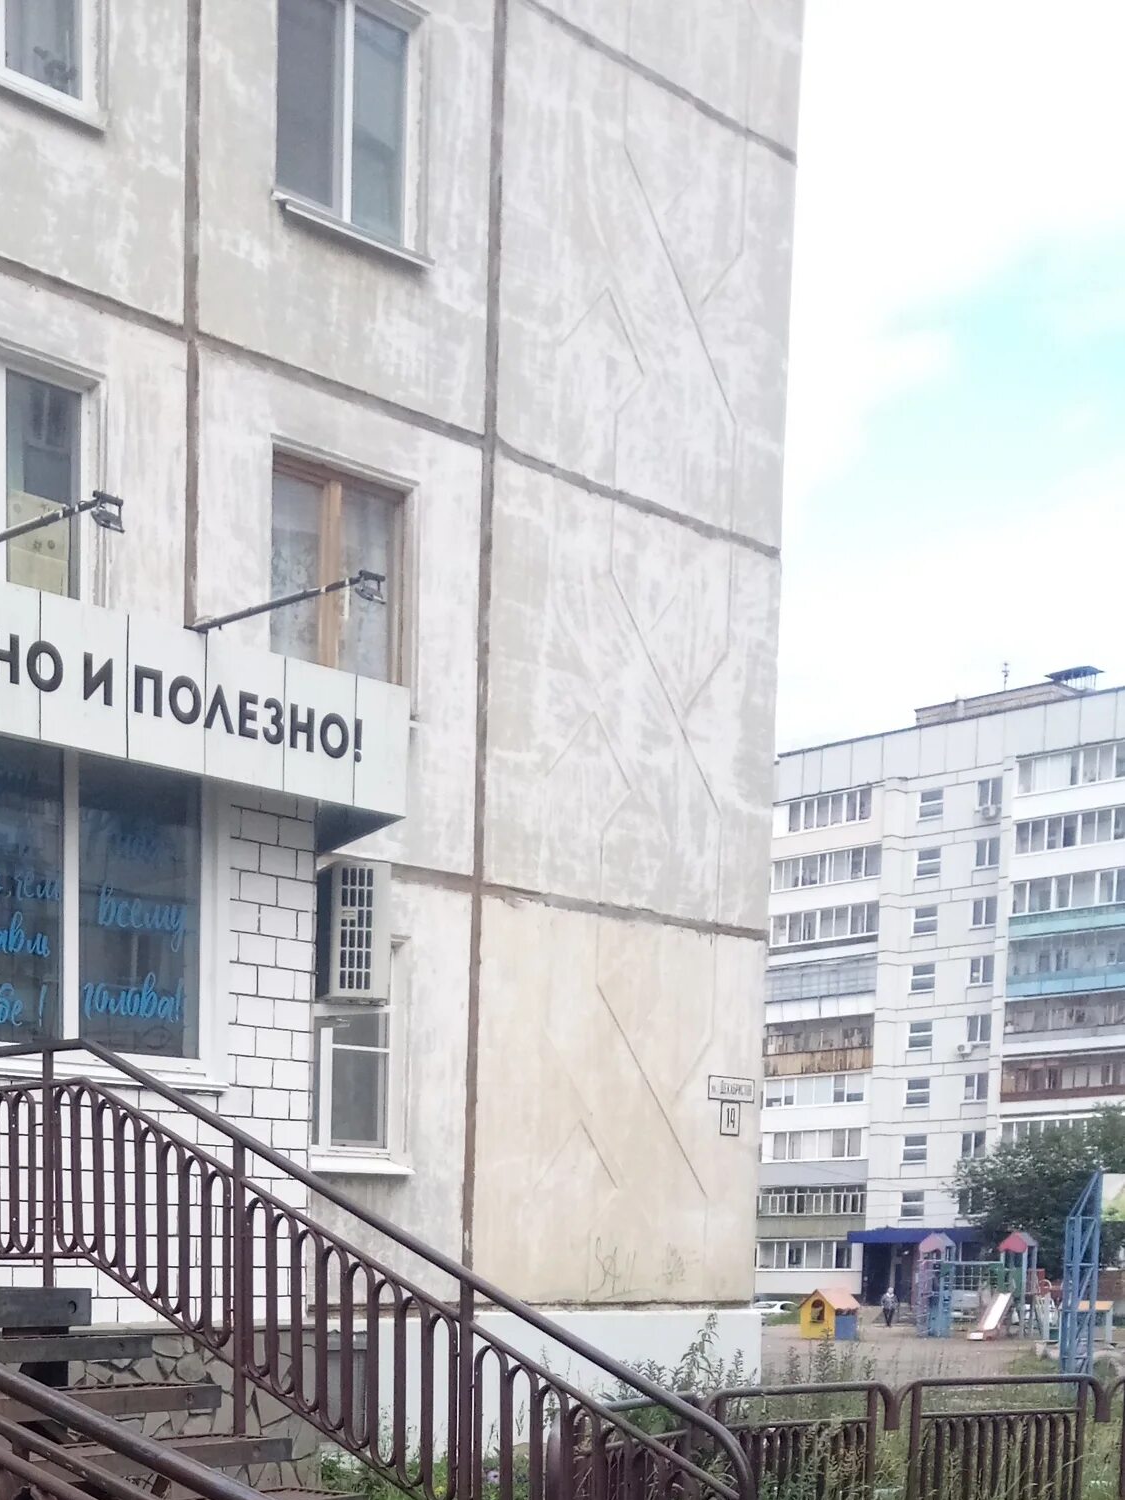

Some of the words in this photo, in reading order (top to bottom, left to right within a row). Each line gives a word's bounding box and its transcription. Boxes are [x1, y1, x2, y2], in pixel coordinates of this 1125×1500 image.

[83, 652, 114, 707] И
[133, 664, 364, 764] ПОЛЕЗНО!
[97, 880, 187, 952] всему
